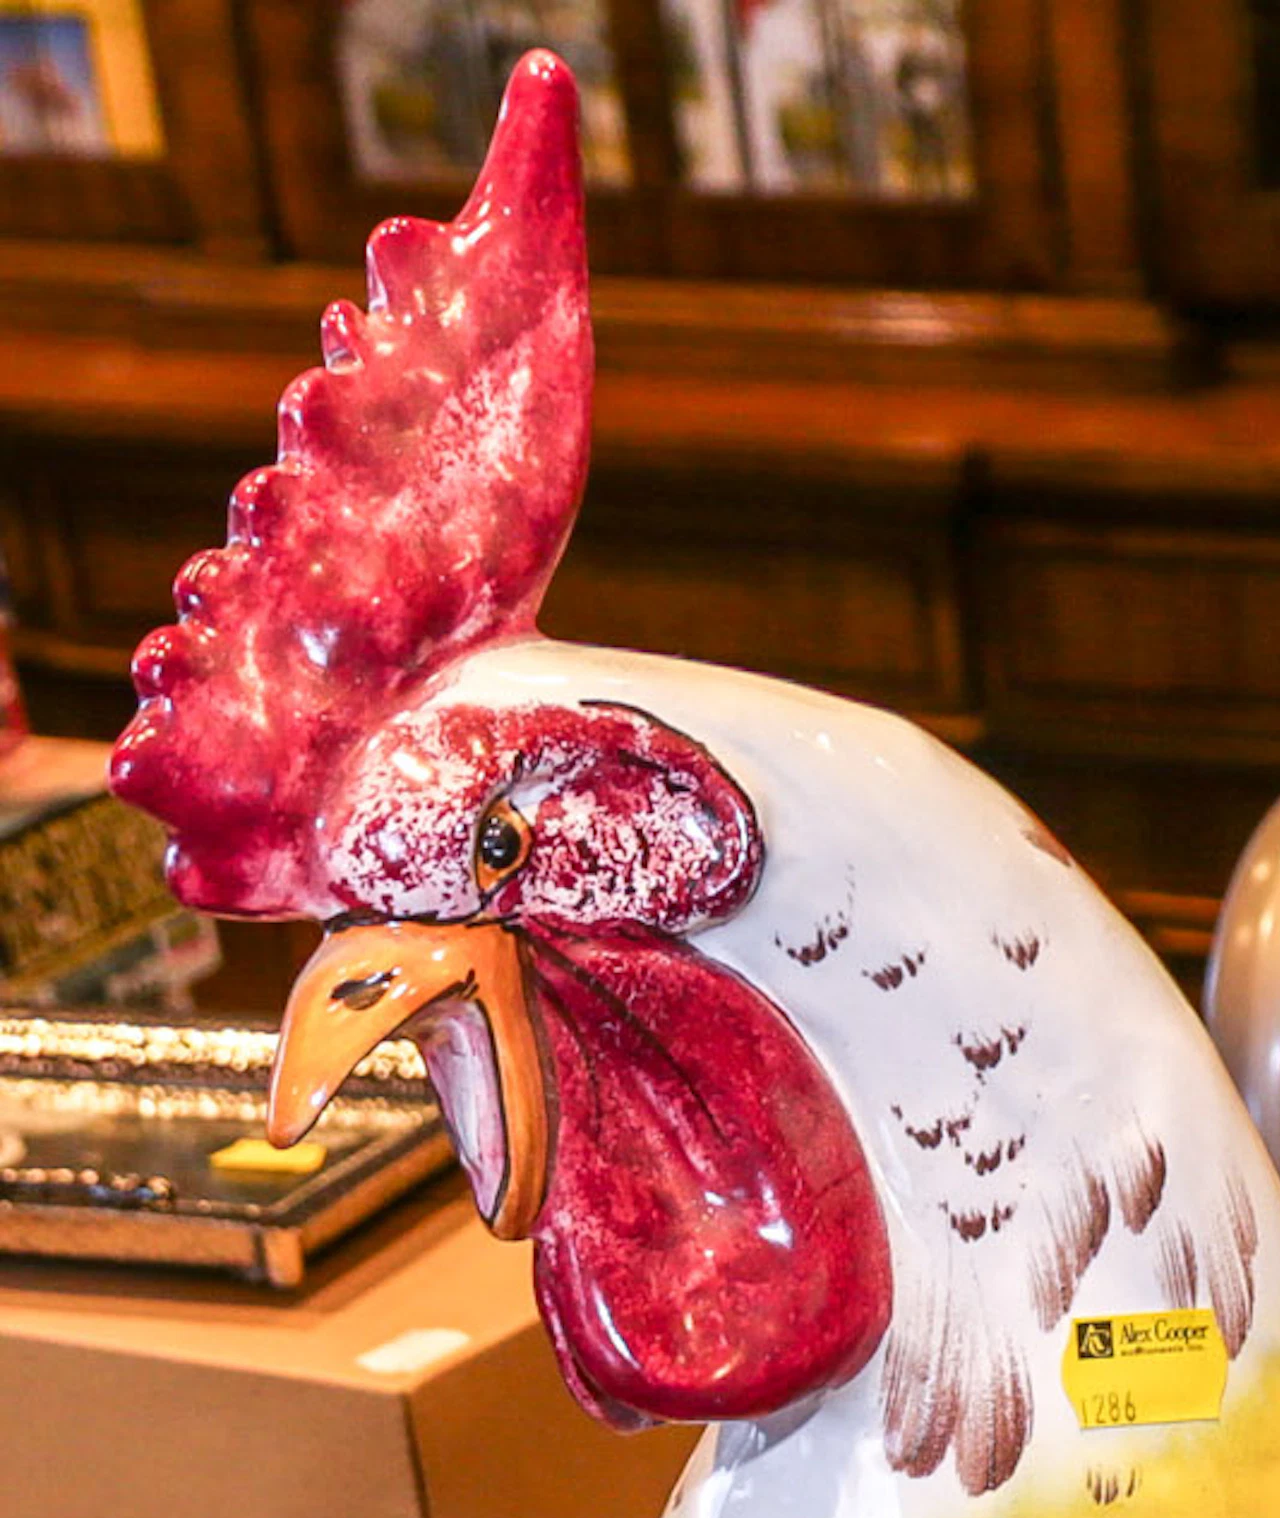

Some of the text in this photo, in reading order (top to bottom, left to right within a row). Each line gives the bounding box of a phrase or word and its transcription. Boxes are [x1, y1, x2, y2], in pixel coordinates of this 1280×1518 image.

[1120, 1318, 1209, 1345] Alex Cooper
[1082, 1391, 1136, 1427] 1286
